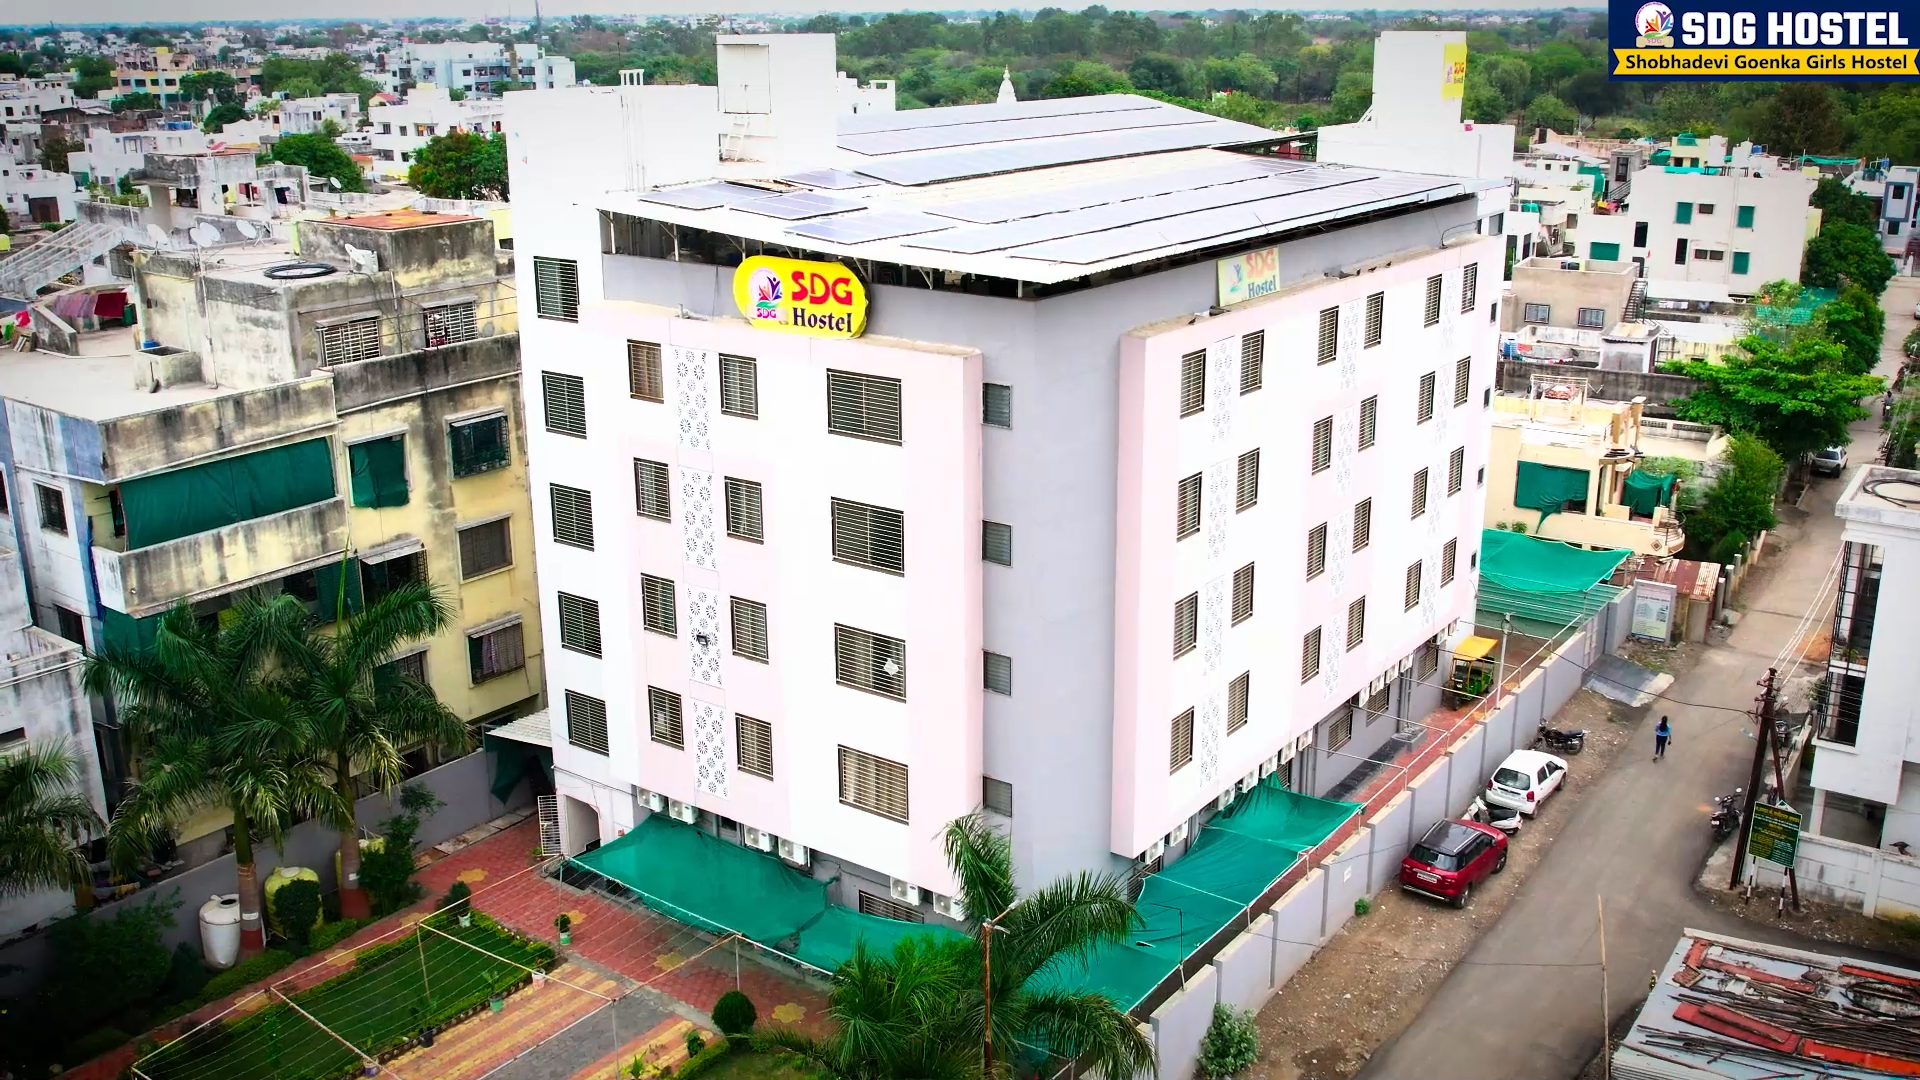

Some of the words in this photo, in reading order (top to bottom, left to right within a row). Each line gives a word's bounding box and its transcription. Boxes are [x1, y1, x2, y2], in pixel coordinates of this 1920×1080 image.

[1246, 248, 1275, 279] SDG
[791, 270, 853, 306] SDG
[1247, 275, 1277, 299] Hostel
[756, 308, 777, 319] SDG
[792, 307, 853, 333] Hostel
